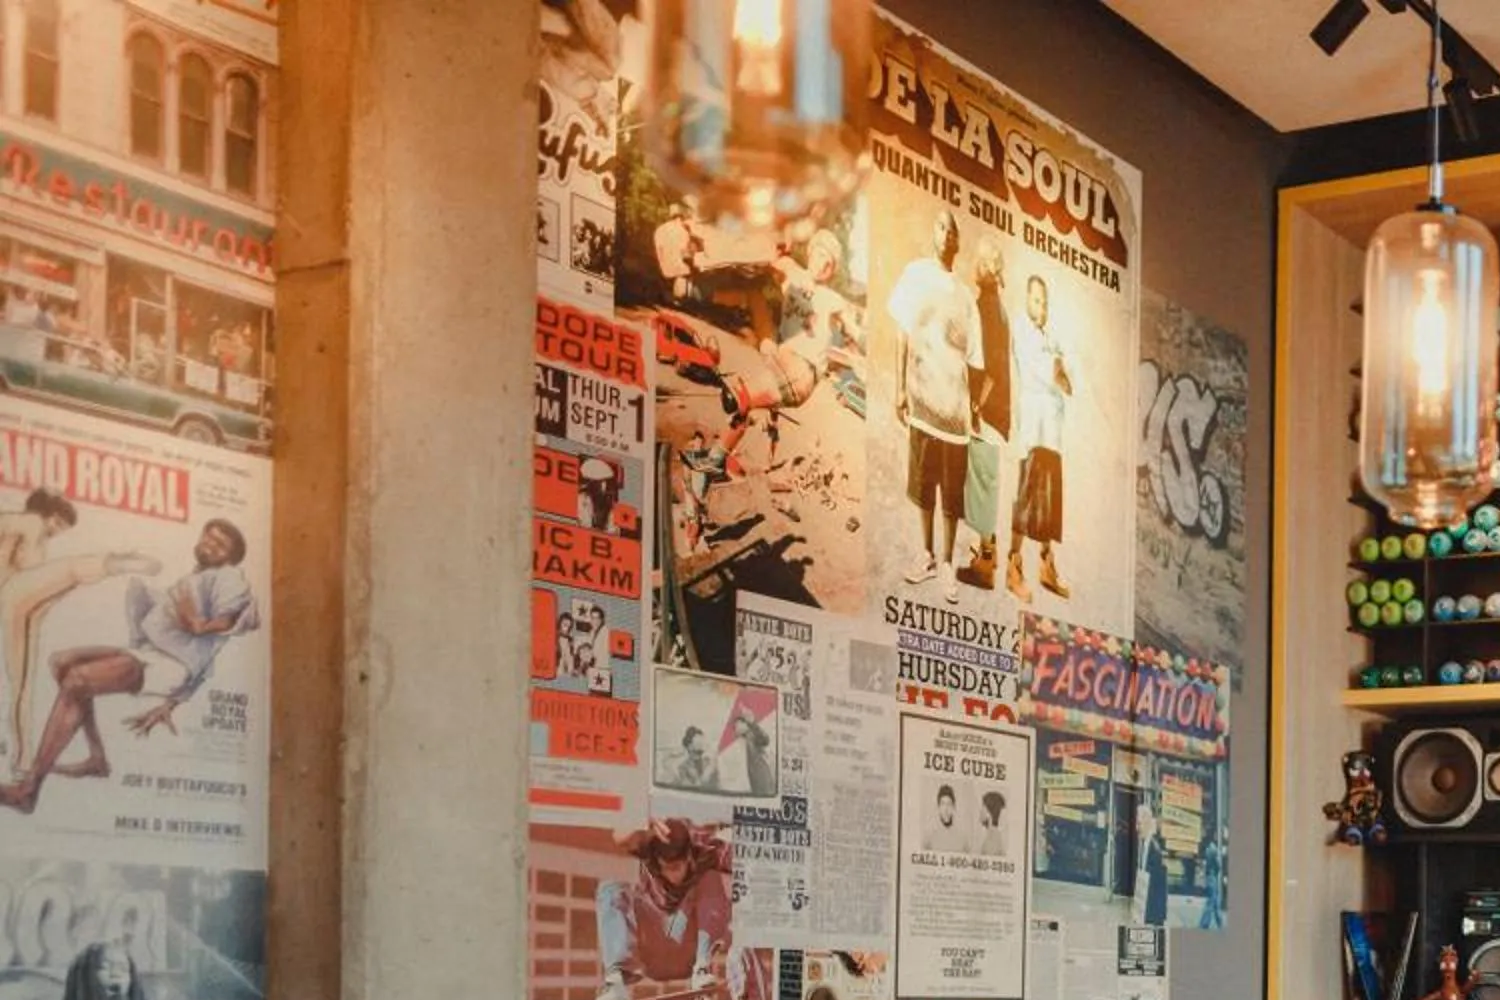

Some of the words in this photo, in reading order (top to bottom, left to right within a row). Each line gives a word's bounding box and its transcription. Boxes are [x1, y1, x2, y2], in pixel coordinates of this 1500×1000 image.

[931, 83, 994, 169] LA
[1005, 130, 1116, 238] SOUL
[873, 139, 960, 207] QUANTIC
[969, 192, 1016, 236] SOUL
[1023, 221, 1120, 293] ORCHESTRA
[537, 302, 635, 355] DOPE
[536, 329, 637, 382] TOUR
[568, 374, 627, 412] THUR.
[571, 401, 623, 438] SEPT.
[0, 431, 69, 496] AND
[75, 450, 187, 519] ROYAL
[540, 524, 573, 550] IC
[885, 595, 1007, 648] SATURDAY
[898, 651, 1007, 699] HURSDAY
[1031, 643, 1217, 733] FASCINATION
[924, 751, 955, 773] ICE
[961, 757, 1007, 781] CUBE
